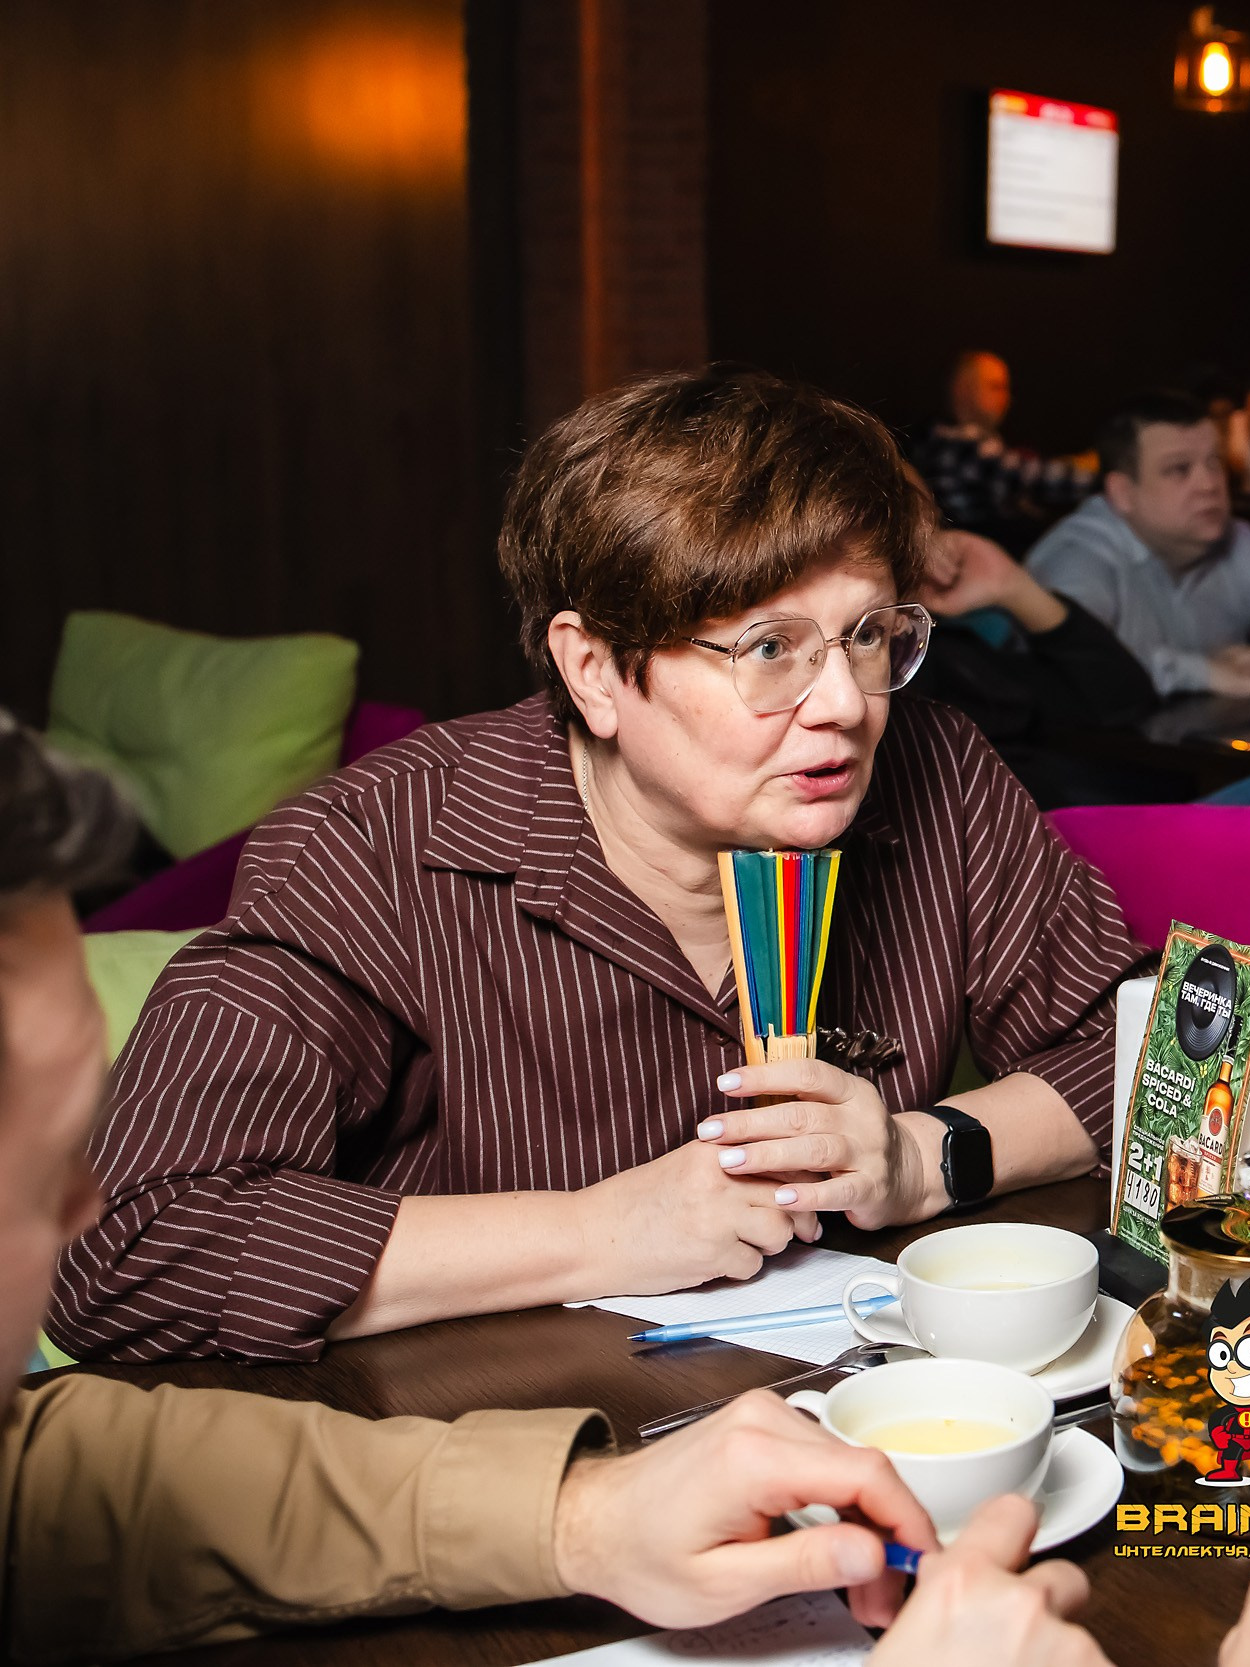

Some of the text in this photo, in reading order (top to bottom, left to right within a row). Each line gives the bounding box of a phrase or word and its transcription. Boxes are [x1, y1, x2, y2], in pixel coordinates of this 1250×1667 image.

[1181, 990, 1231, 1019] ТАМ, ГДЕ ТЫ
[1182, 981, 1232, 1009] ВЕЧЕРИНКА
[1142, 1073, 1192, 1108] SPICED &
[1147, 1093, 1177, 1118] COLA
[1128, 1141, 1163, 1181] 2+1
